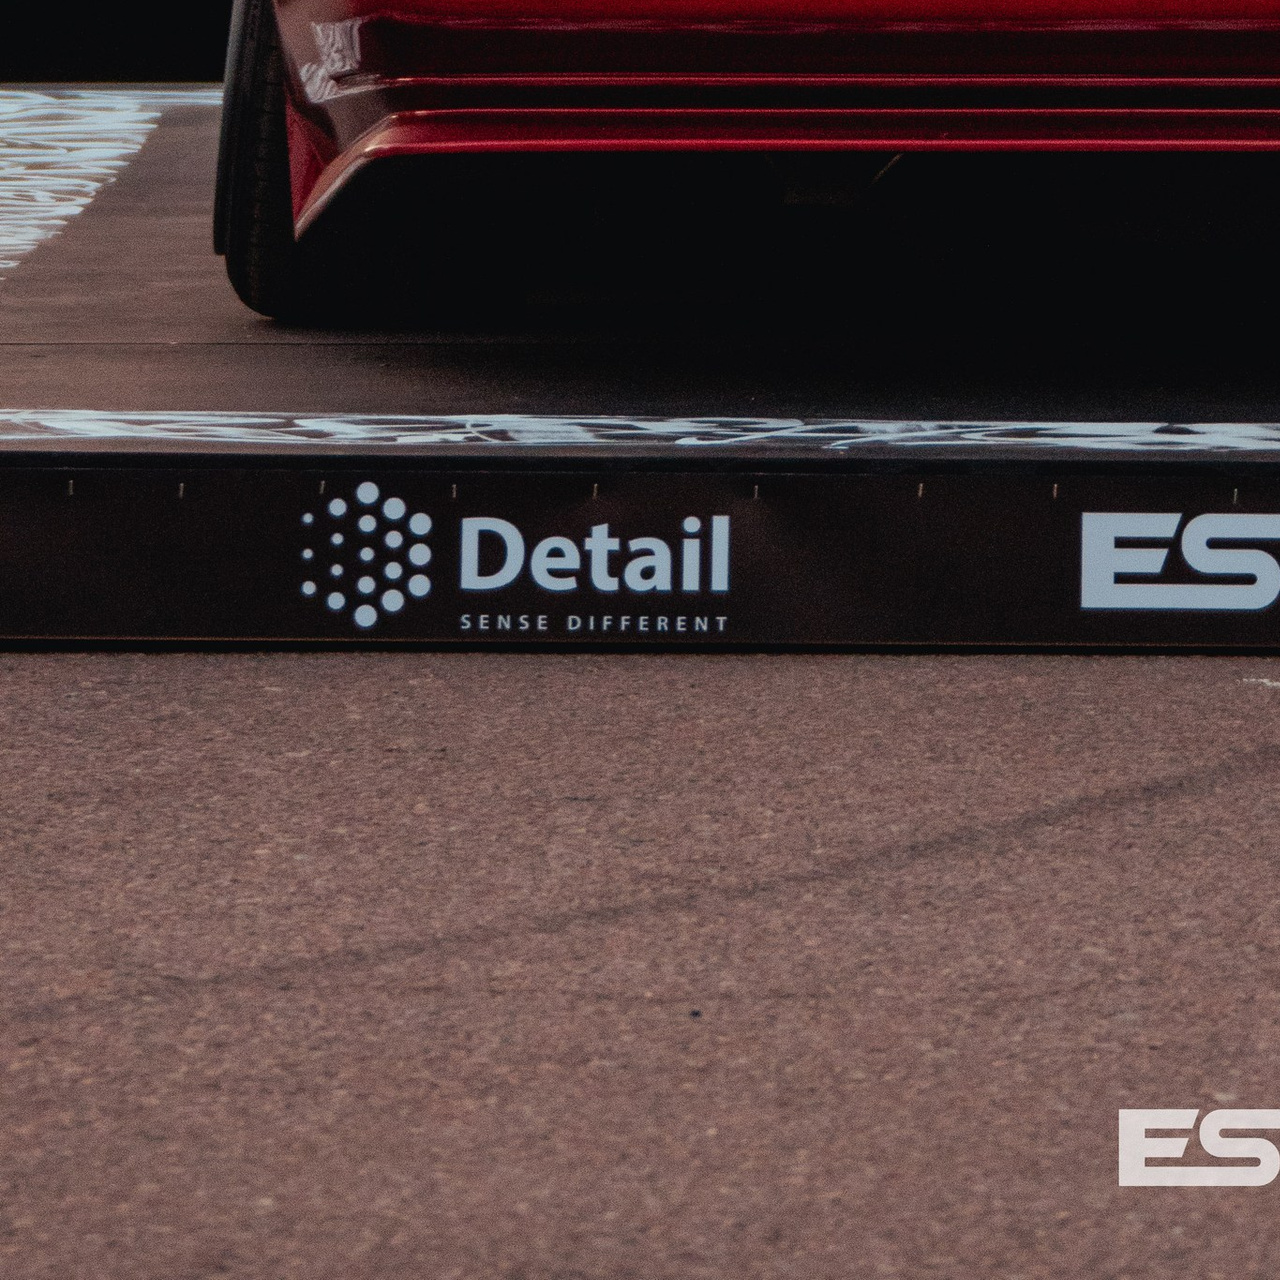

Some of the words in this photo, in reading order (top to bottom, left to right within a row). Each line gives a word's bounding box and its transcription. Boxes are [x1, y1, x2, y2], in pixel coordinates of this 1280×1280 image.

[460, 515, 731, 592] Detail
[460, 613, 549, 630] SENSE
[567, 615, 729, 632] DIFFERENT
